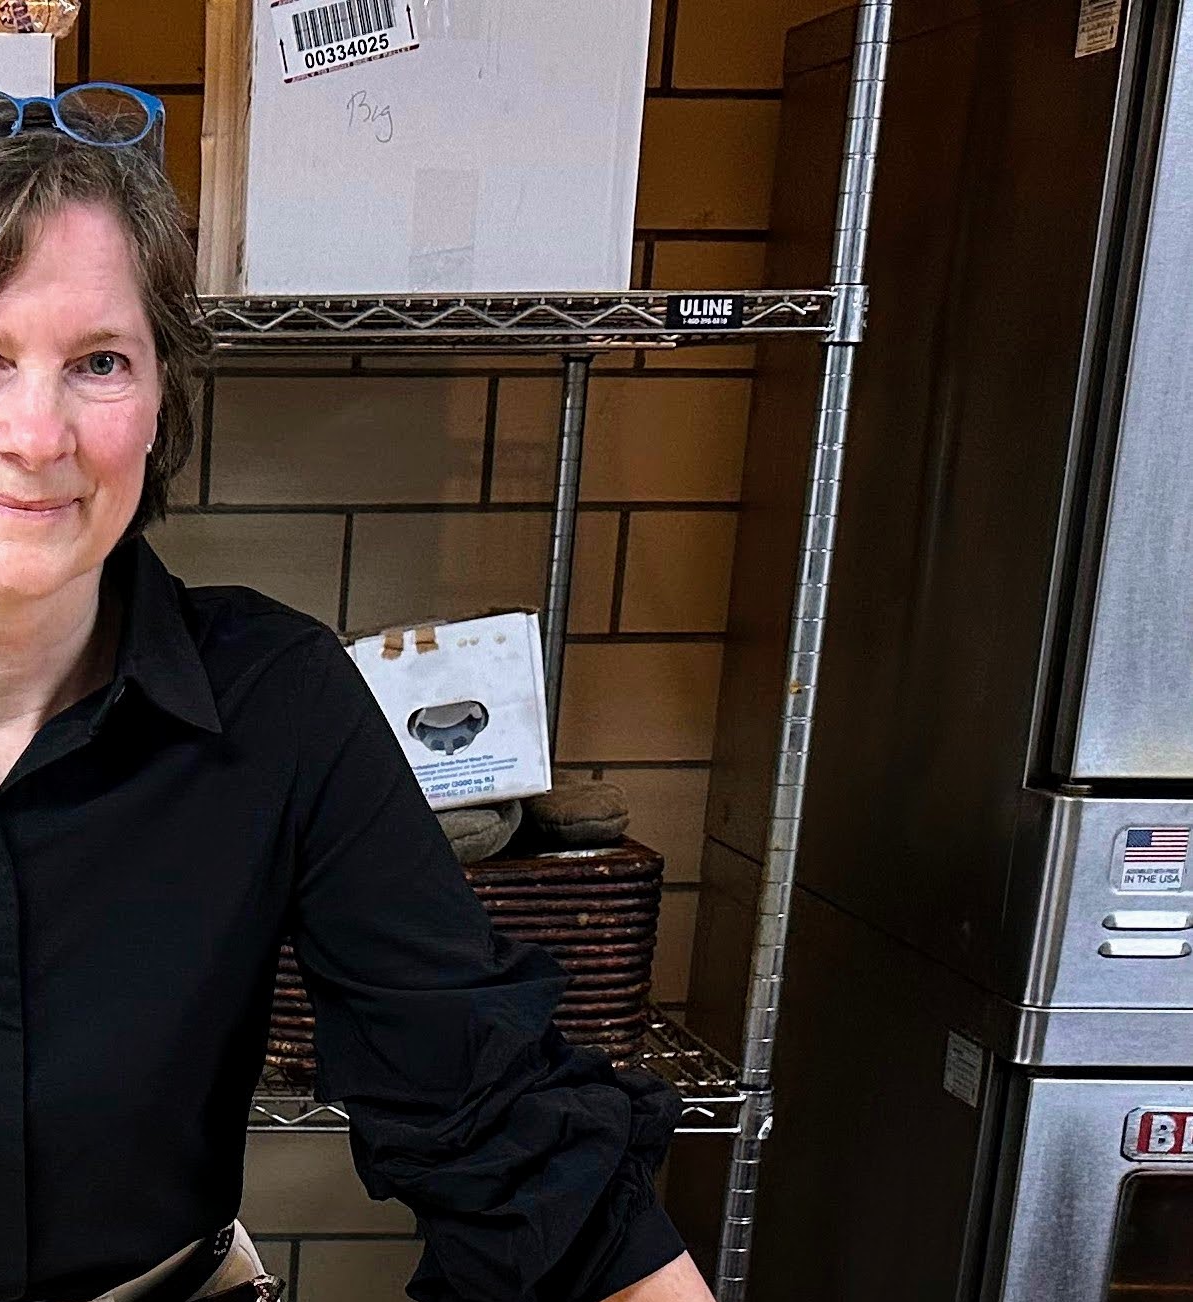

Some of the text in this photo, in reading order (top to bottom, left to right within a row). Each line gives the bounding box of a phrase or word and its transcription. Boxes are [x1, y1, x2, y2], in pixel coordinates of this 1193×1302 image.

[304, 33, 390, 69] 00334025
[679, 298, 734, 317] ULINE
[1123, 874, 1181, 884] IN THE USA
